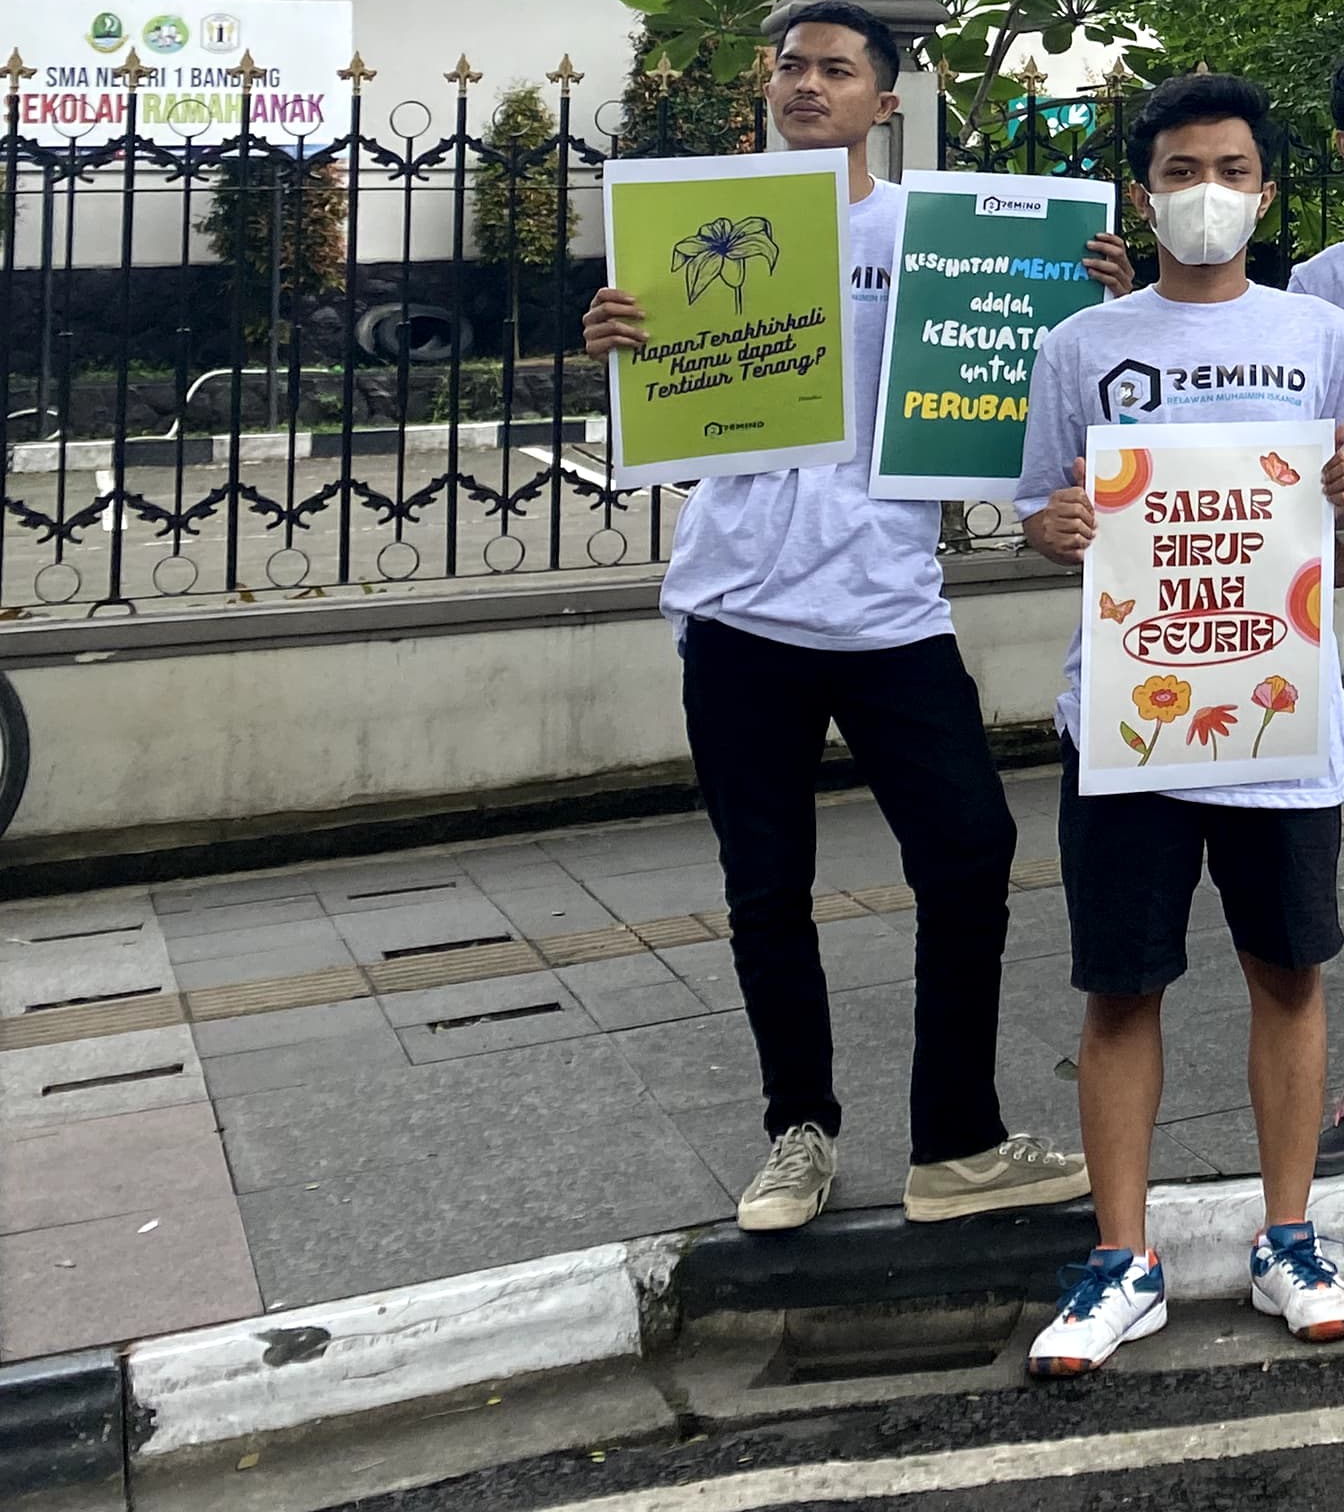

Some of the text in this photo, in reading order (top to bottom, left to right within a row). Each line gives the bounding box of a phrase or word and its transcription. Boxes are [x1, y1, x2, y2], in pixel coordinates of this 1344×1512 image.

[46, 67, 88, 87] SMA
[174, 67, 182, 87] 1
[191, 67, 280, 88] BANDNG
[143, 92, 242, 124] RAMAH
[249, 92, 325, 124] ANAK
[905, 252, 1090, 281] KESEHATAN MENTA
[970, 292, 1033, 318] adalah
[922, 319, 1051, 350] KEKUATA
[670, 333, 797, 376] Kamu dapat
[960, 354, 1028, 384] untuk
[645, 346, 827, 402] Tertidur Tenang?
[1166, 364, 1306, 392] REMIND
[1167, 395, 1214, 406] RELAWAN
[1215, 391, 1265, 402] MUHAIMIN
[1144, 488, 1274, 524] SABAR
[1152, 531, 1265, 568] HIRUP
[1158, 575, 1246, 612] MAH
[1138, 618, 1276, 657] PEURIH
